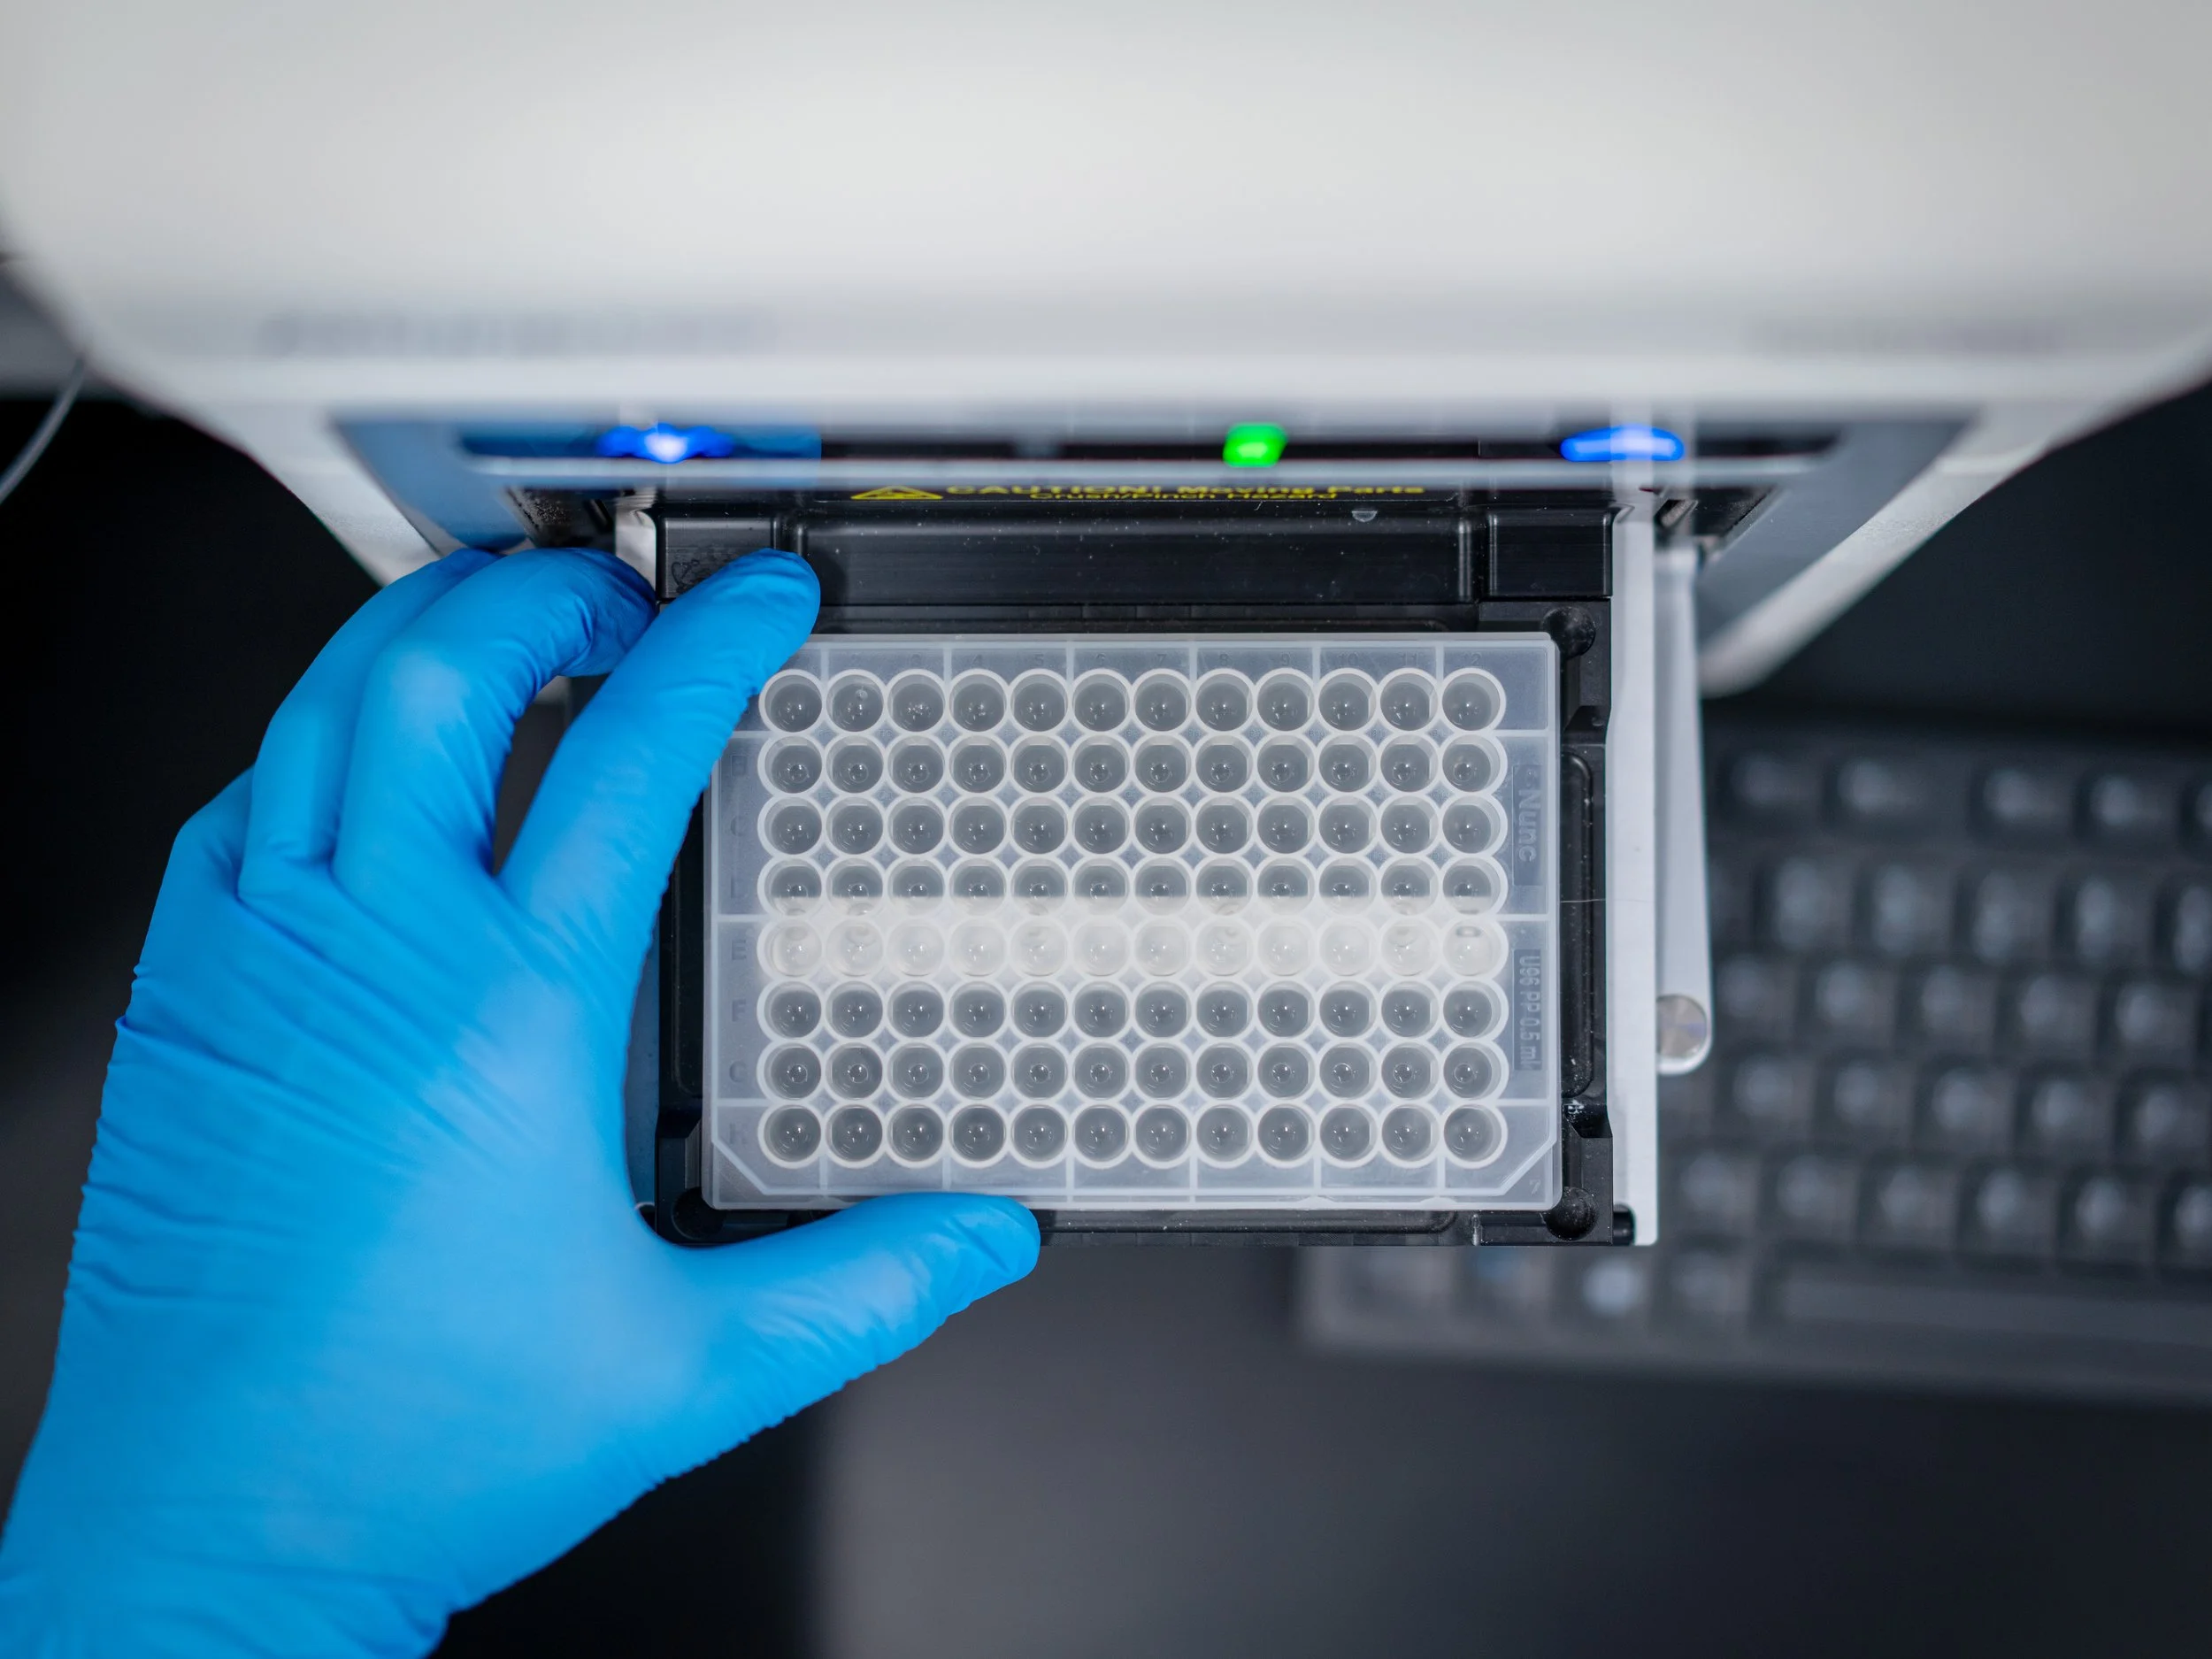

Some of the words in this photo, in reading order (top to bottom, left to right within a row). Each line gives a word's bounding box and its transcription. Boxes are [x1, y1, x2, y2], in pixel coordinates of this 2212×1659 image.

[1178, 485, 1312, 495] Moving
[1327, 485, 1424, 495] Parts
[1517, 789, 1541, 863] Nunc
[731, 939, 746, 960] E
[1519, 956, 1541, 986] U96
[731, 1000, 746, 1022] F
[1519, 990, 1541, 1012] PP
[1519, 1018, 1541, 1041] 0.5
[1519, 1046, 1541, 1065] ml
